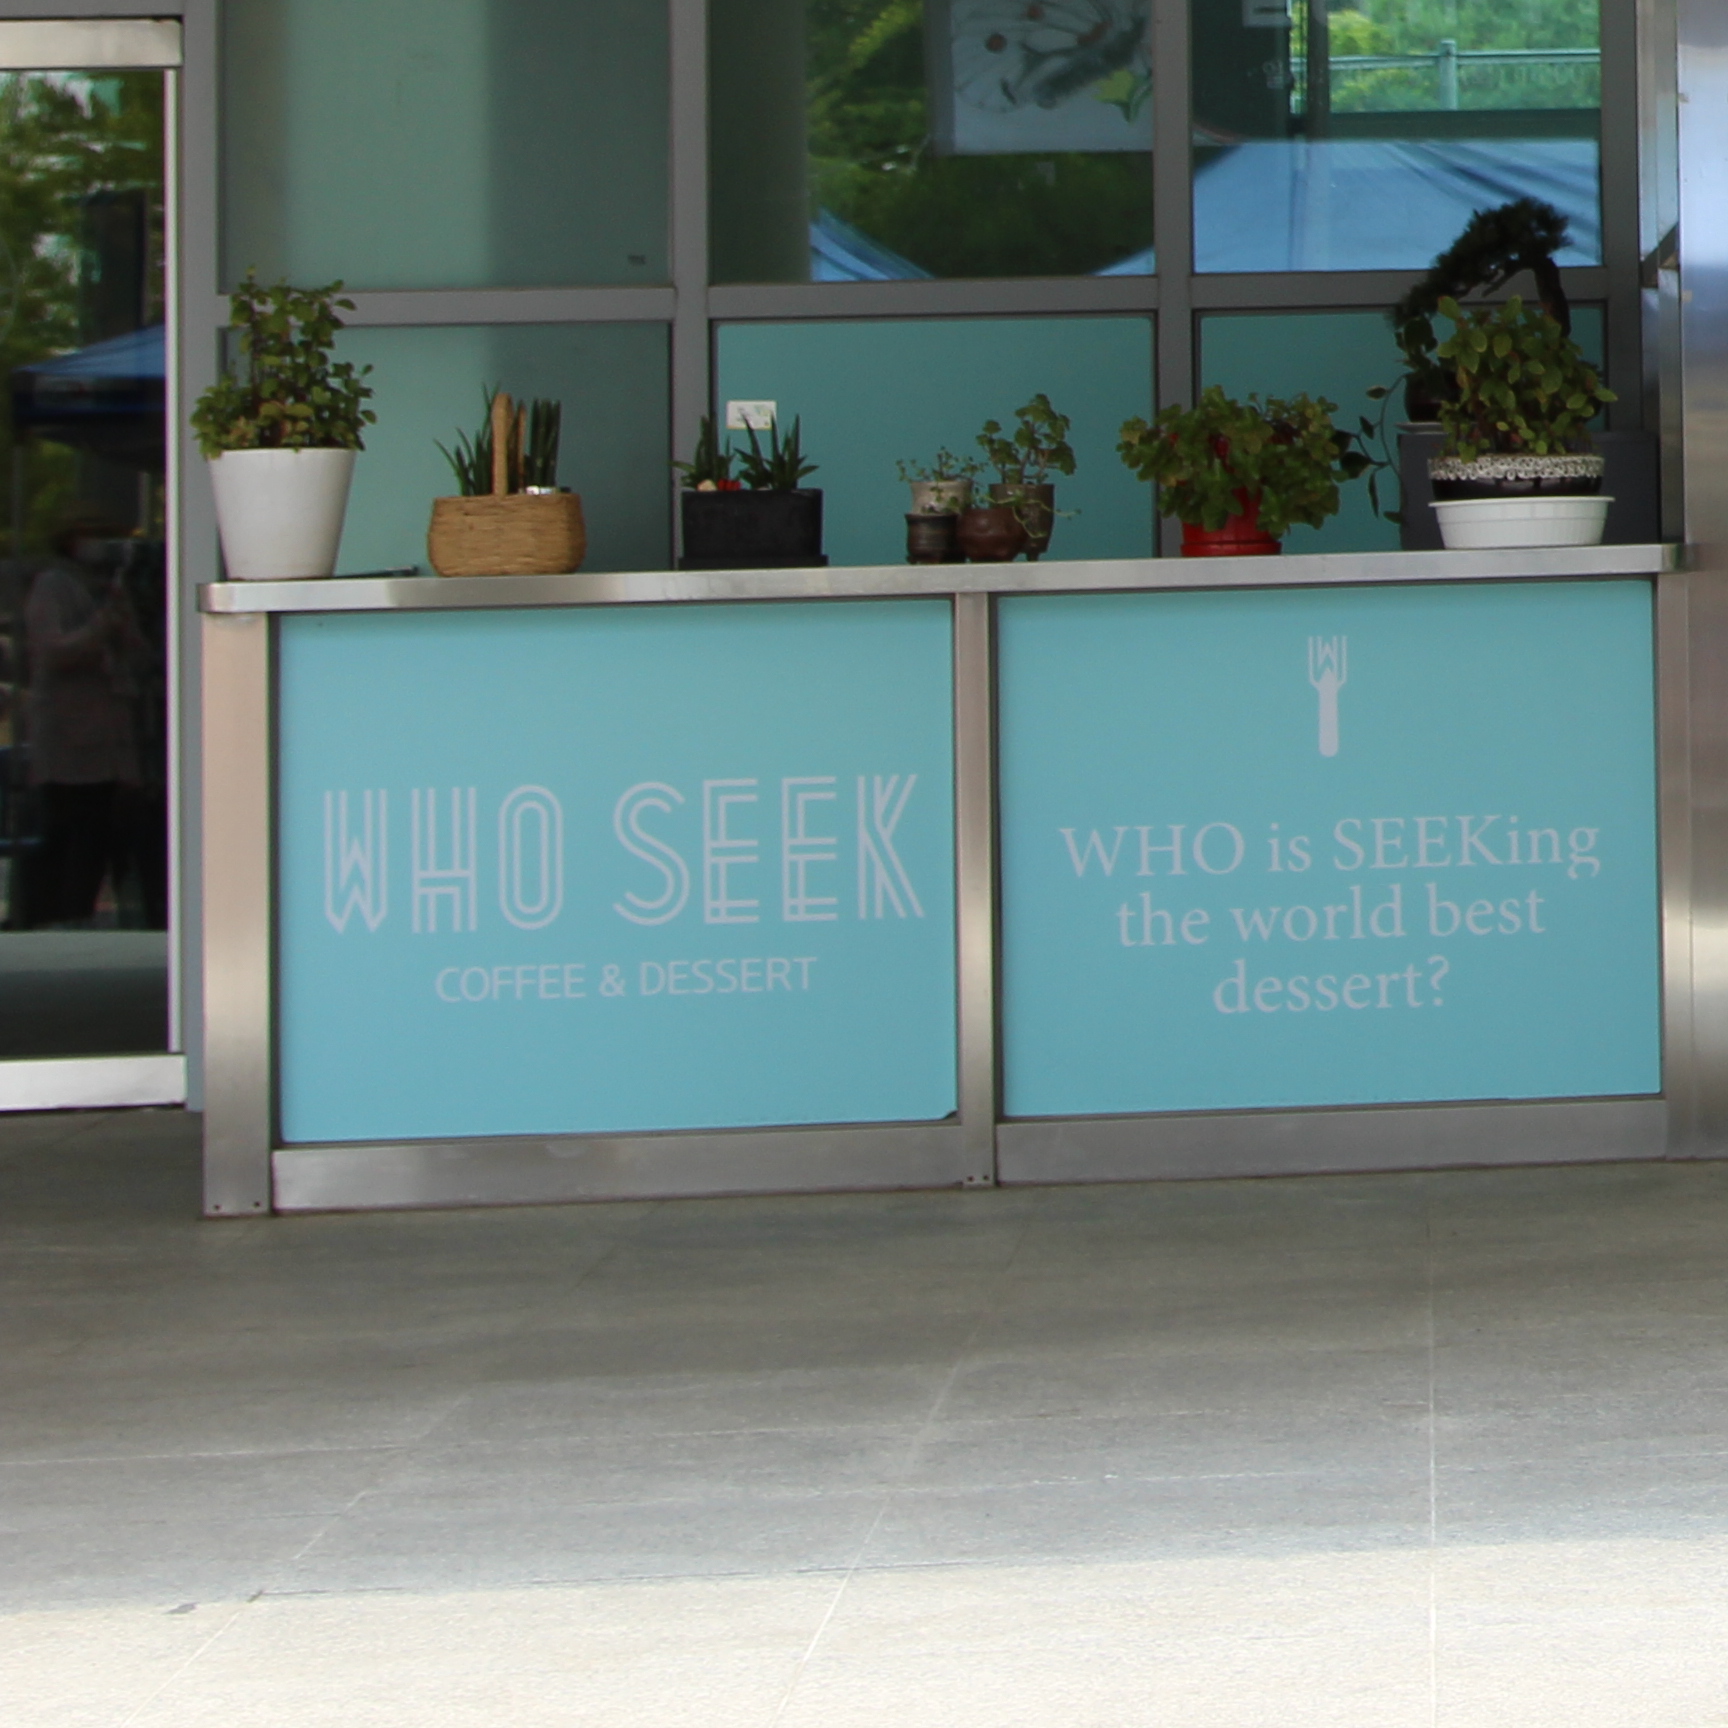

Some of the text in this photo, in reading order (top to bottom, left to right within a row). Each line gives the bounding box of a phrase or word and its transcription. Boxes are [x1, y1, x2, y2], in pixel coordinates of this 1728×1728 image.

[325, 774, 924, 932] WHO SEEK
[1060, 814, 1602, 880] WHO is SEEKing
[1117, 883, 1546, 947] the world best
[435, 956, 818, 1003] COFFEE & DESSERT
[1212, 954, 1450, 1014] dessert?
